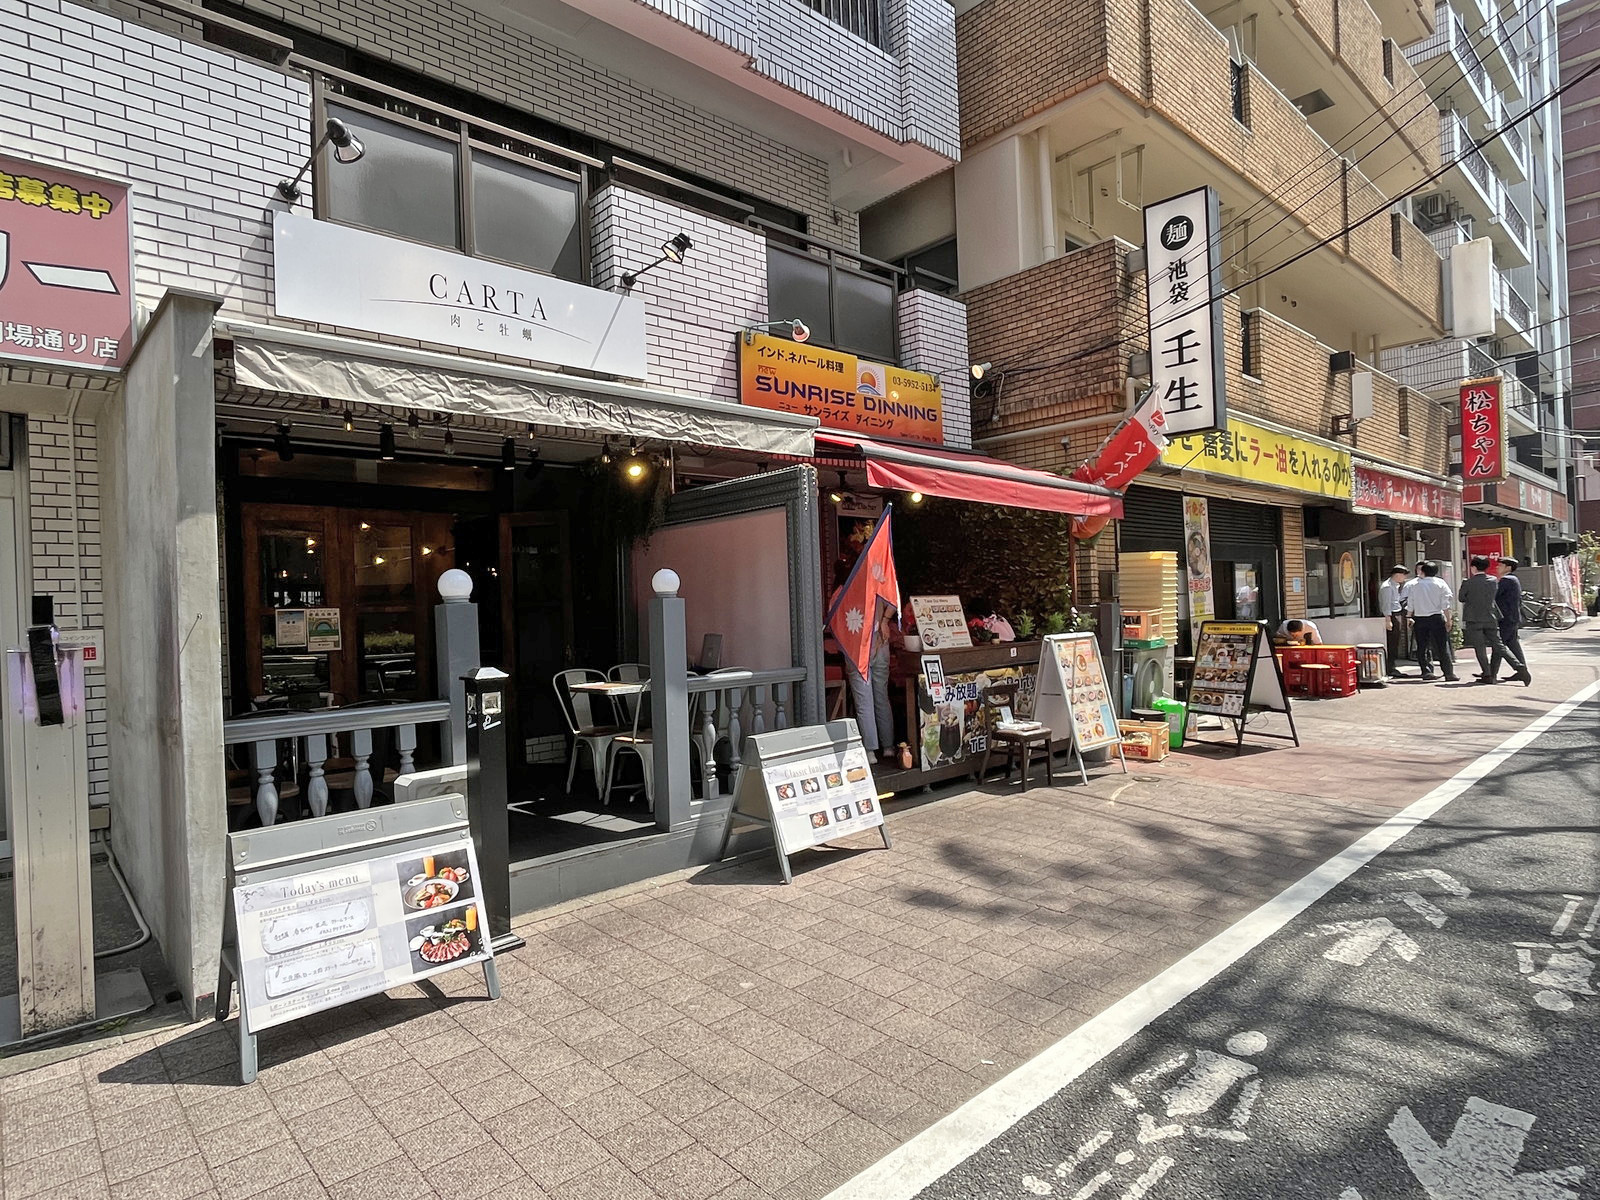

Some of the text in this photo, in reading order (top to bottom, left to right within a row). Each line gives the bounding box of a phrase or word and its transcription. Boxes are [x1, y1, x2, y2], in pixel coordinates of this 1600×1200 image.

[429, 273, 548, 321] CARTA
[1167, 257, 1190, 305] 池袋
[755, 374, 938, 422] SUNRISE DINNING
[778, 401, 894, 430] ニュー サンライズ ダイニング
[1465, 389, 1496, 477] 松ちゃん
[934, 681, 977, 705] み放題
[784, 767, 807, 778] Classic
[280, 874, 359, 898] Today's menu
